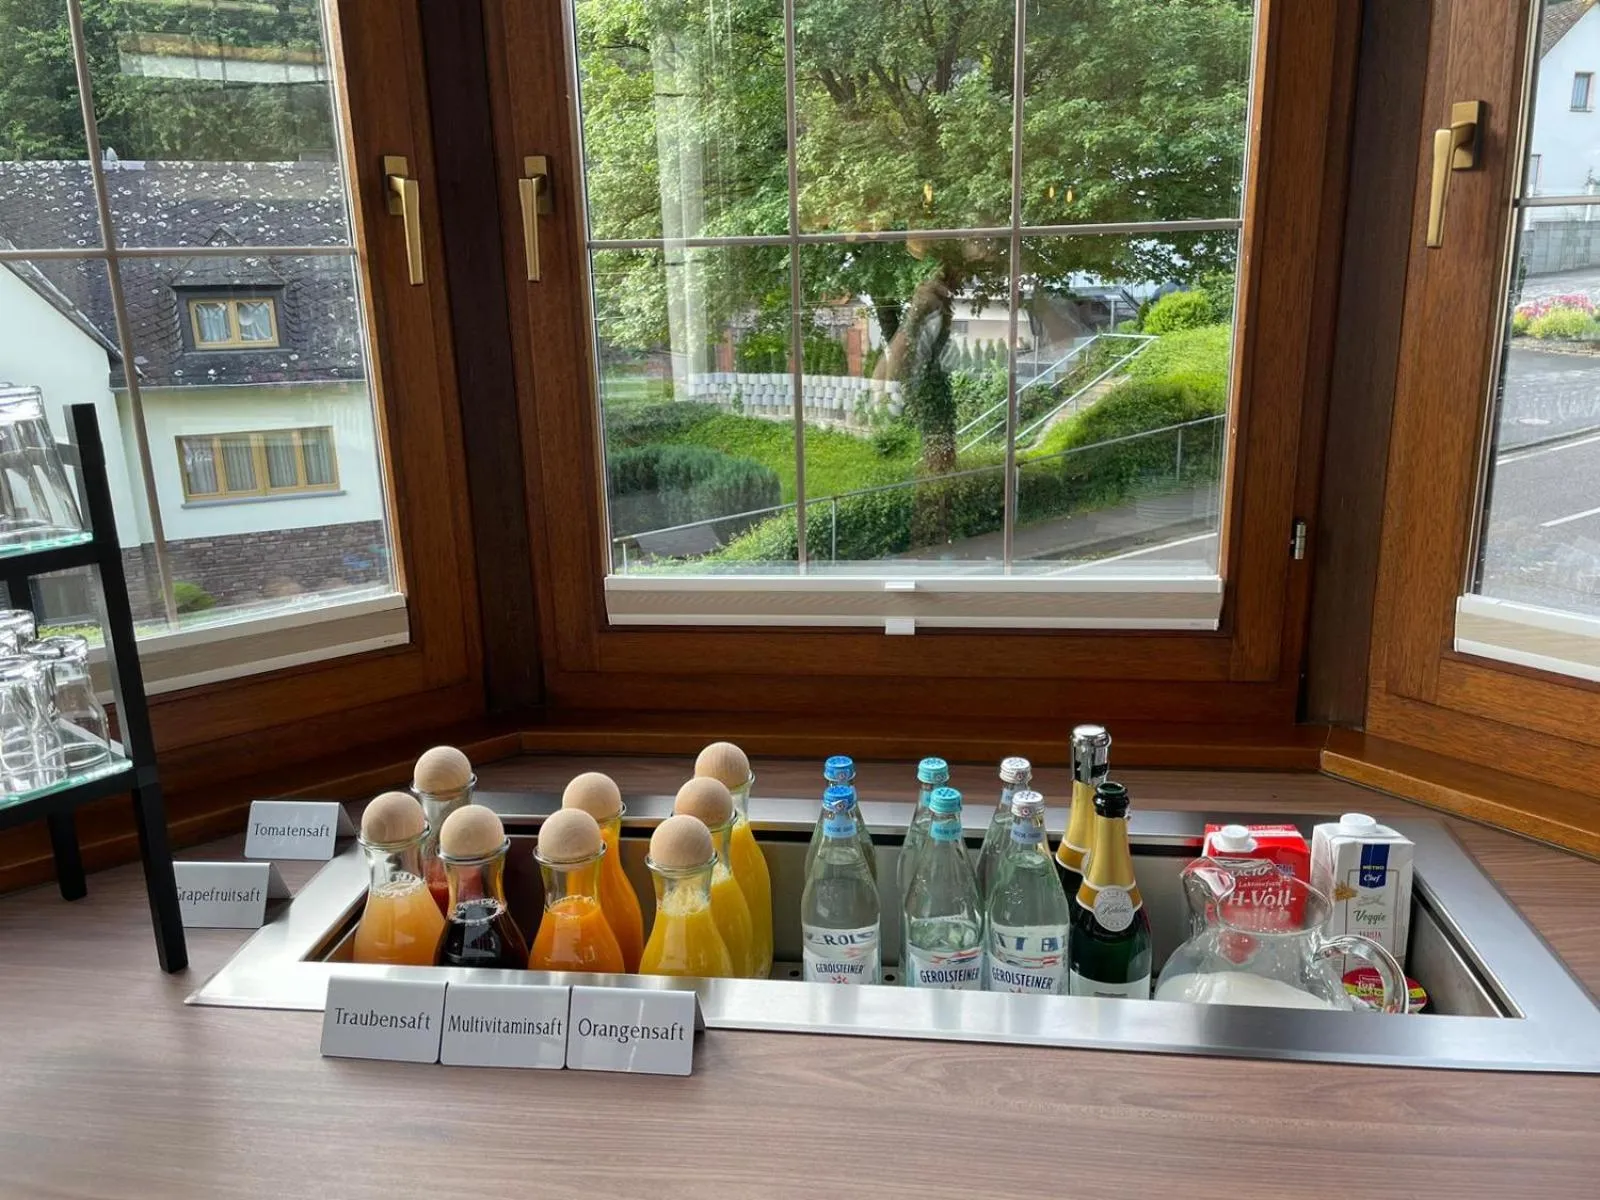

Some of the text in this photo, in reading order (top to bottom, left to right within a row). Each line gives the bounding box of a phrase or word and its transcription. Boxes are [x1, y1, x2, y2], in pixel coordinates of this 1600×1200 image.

[254, 822, 330, 838] Tomatensaft
[1363, 873, 1383, 883] Chef
[1352, 909, 1387, 925] Veggie
[815, 962, 864, 975] GEROLSTEINER
[919, 966, 980, 984] GEROLSTEINER
[991, 966, 1053, 991] GEROLSTEINER
[335, 1007, 432, 1032] Traubensaft
[447, 1014, 563, 1038] Multivitaminsaft
[578, 1017, 685, 1044] Orangensaft
